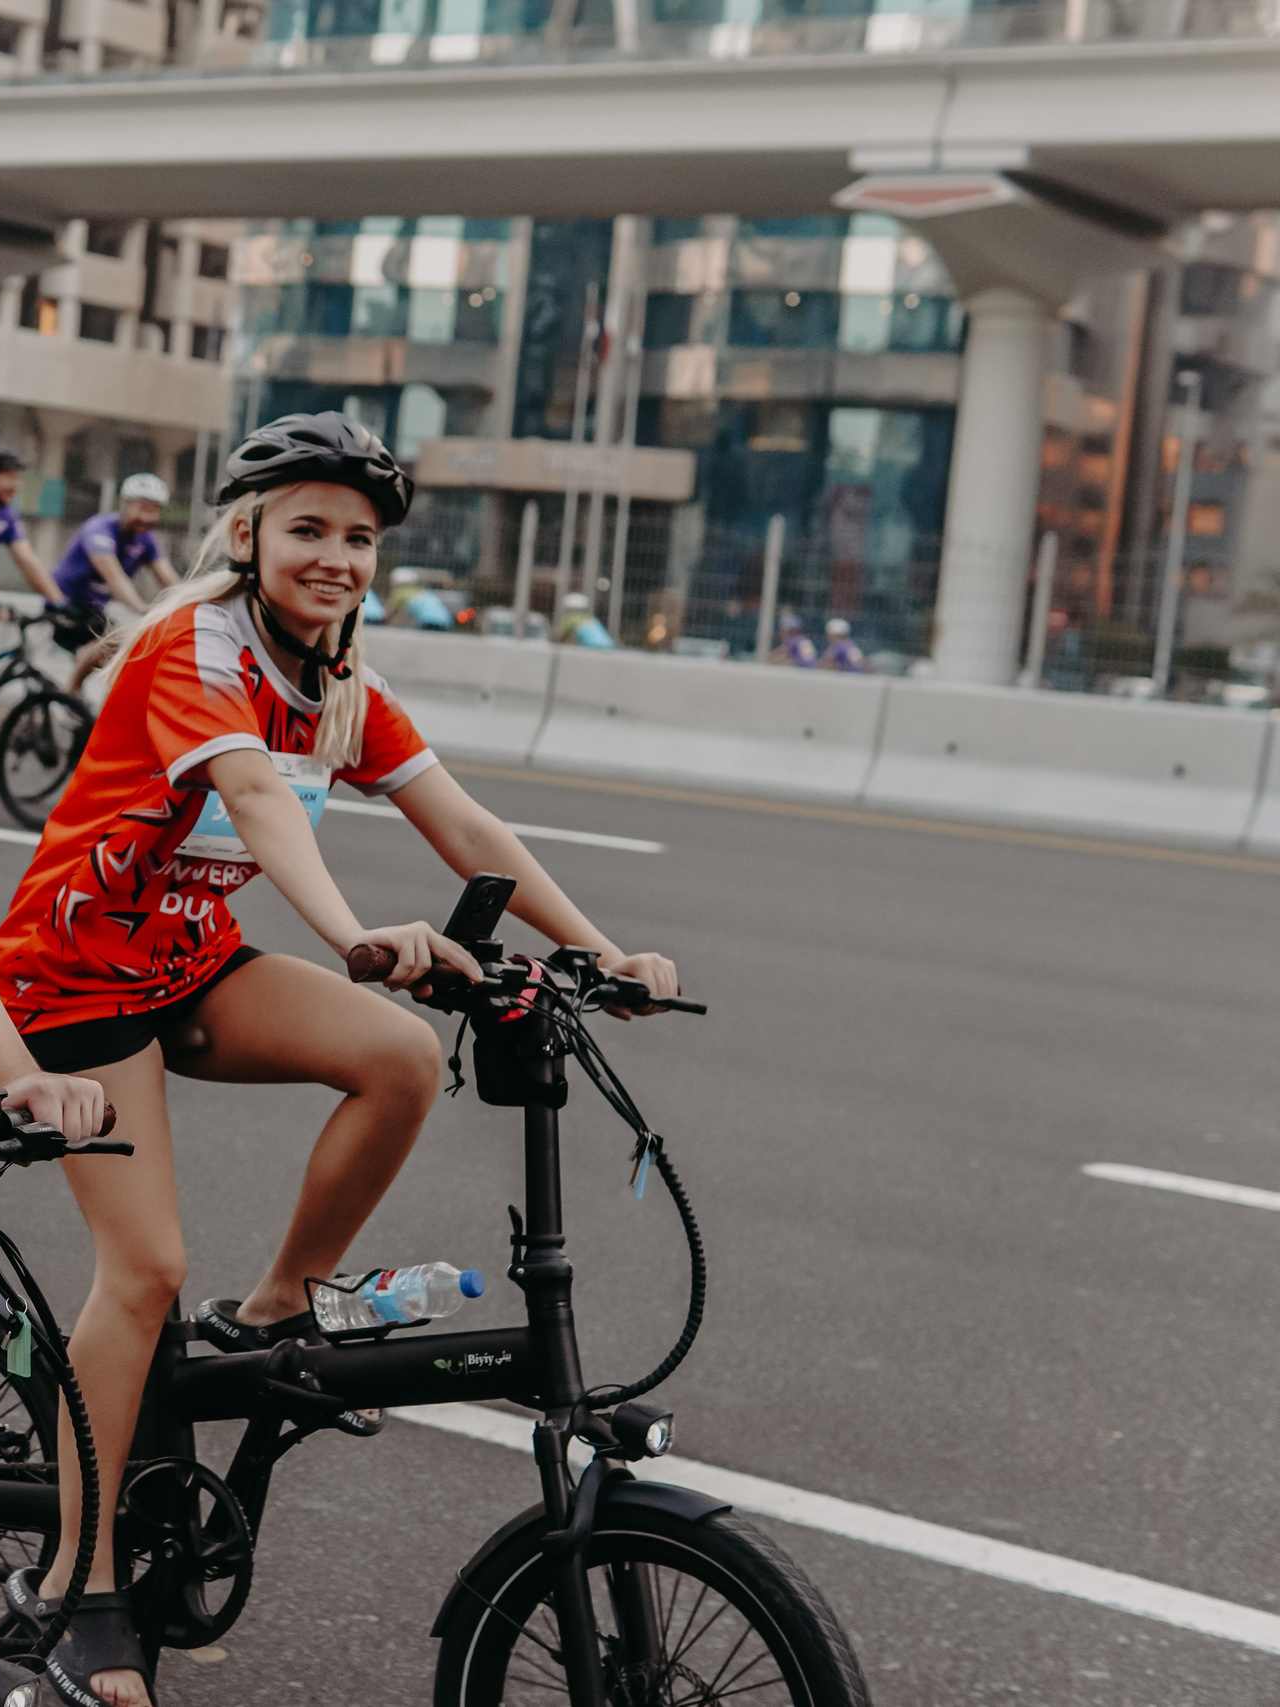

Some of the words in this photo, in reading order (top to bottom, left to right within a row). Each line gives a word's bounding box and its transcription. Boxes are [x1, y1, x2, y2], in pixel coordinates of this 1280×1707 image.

[208, 1314, 240, 1338] WORLD
[468, 1352, 494, 1367] Biyiy
[338, 1410, 365, 1429] RLD
[9, 1578, 27, 1605] WORLD
[48, 1661, 64, 1679] AM
[58, 1673, 77, 1695] THE
[72, 1689, 100, 1707] KING
